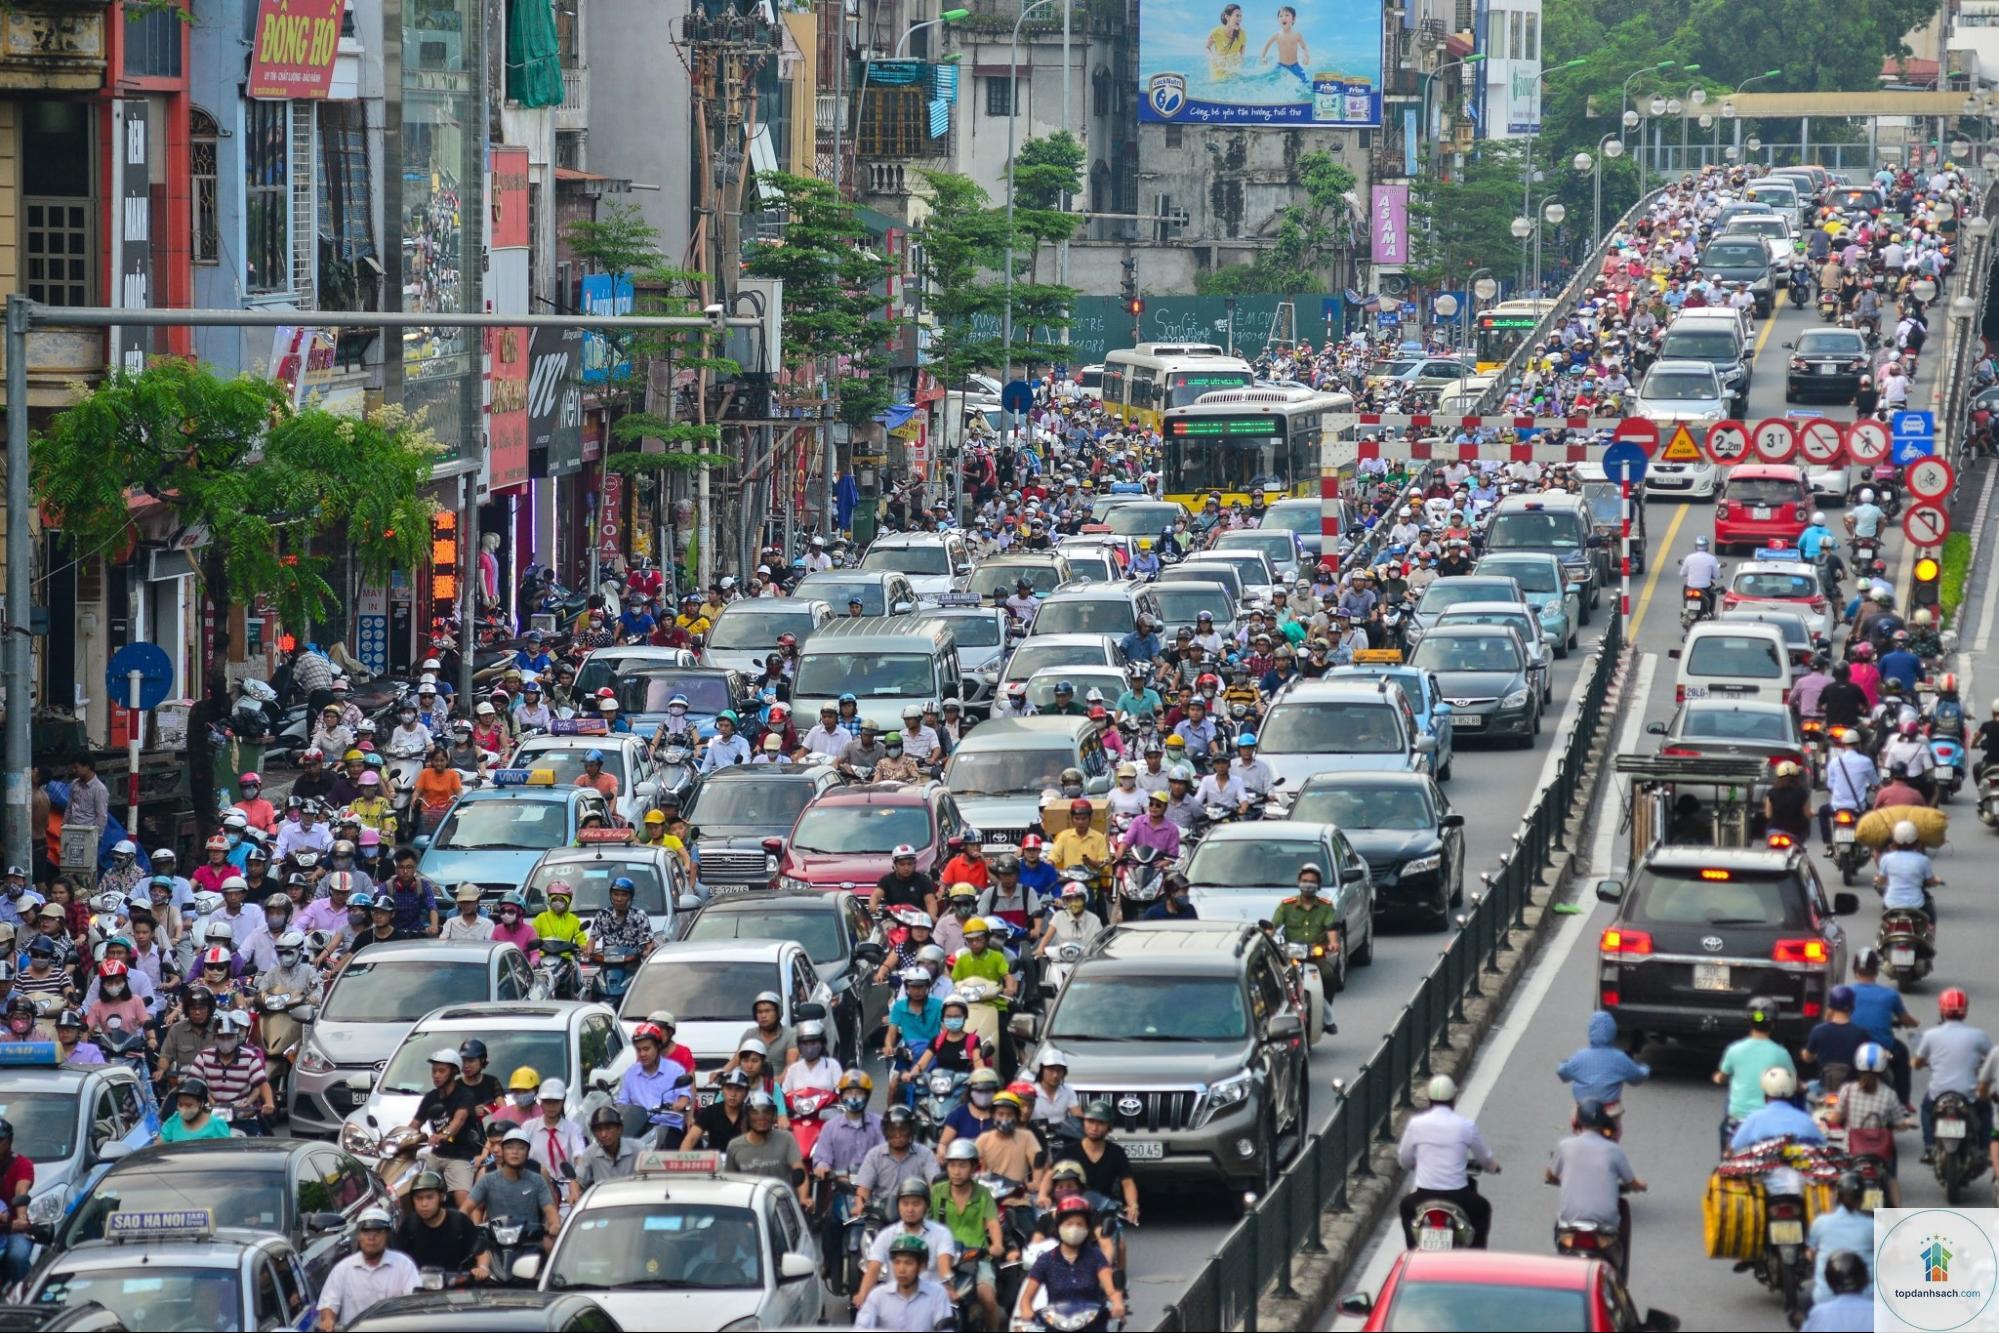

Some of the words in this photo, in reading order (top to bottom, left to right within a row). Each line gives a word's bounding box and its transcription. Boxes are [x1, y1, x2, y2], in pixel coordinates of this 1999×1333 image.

[1377, 195, 1396, 257] ASAMA
[368, 603, 377, 611] IN
[114, 1215, 140, 1229] SAO
